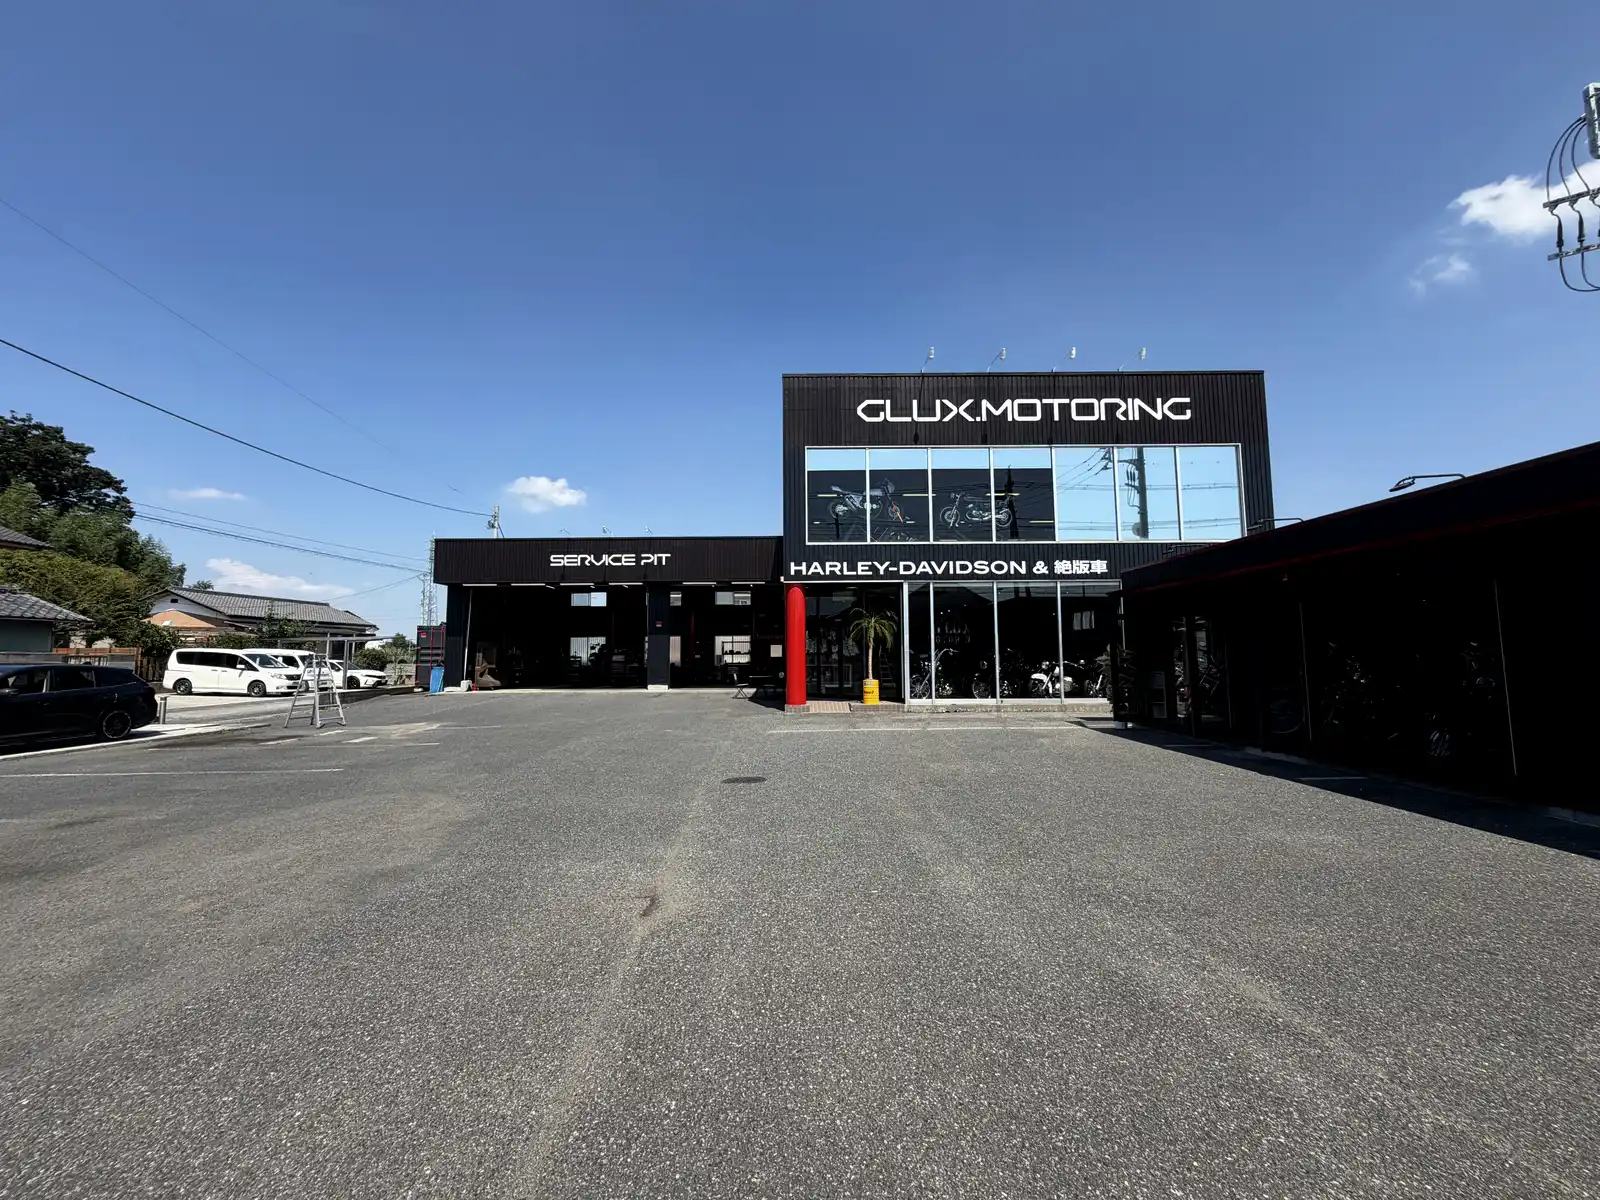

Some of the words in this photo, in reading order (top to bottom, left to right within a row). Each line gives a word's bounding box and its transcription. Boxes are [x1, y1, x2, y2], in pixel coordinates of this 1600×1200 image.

[856, 397, 1192, 423] GLUX.MOTORING
[549, 553, 636, 567] SERVICE
[640, 553, 672, 567] PIT
[790, 560, 1027, 576] HARLEY-DAVIDSON
[1032, 560, 1049, 575] &
[1053, 559, 1109, 575] 絶版車
